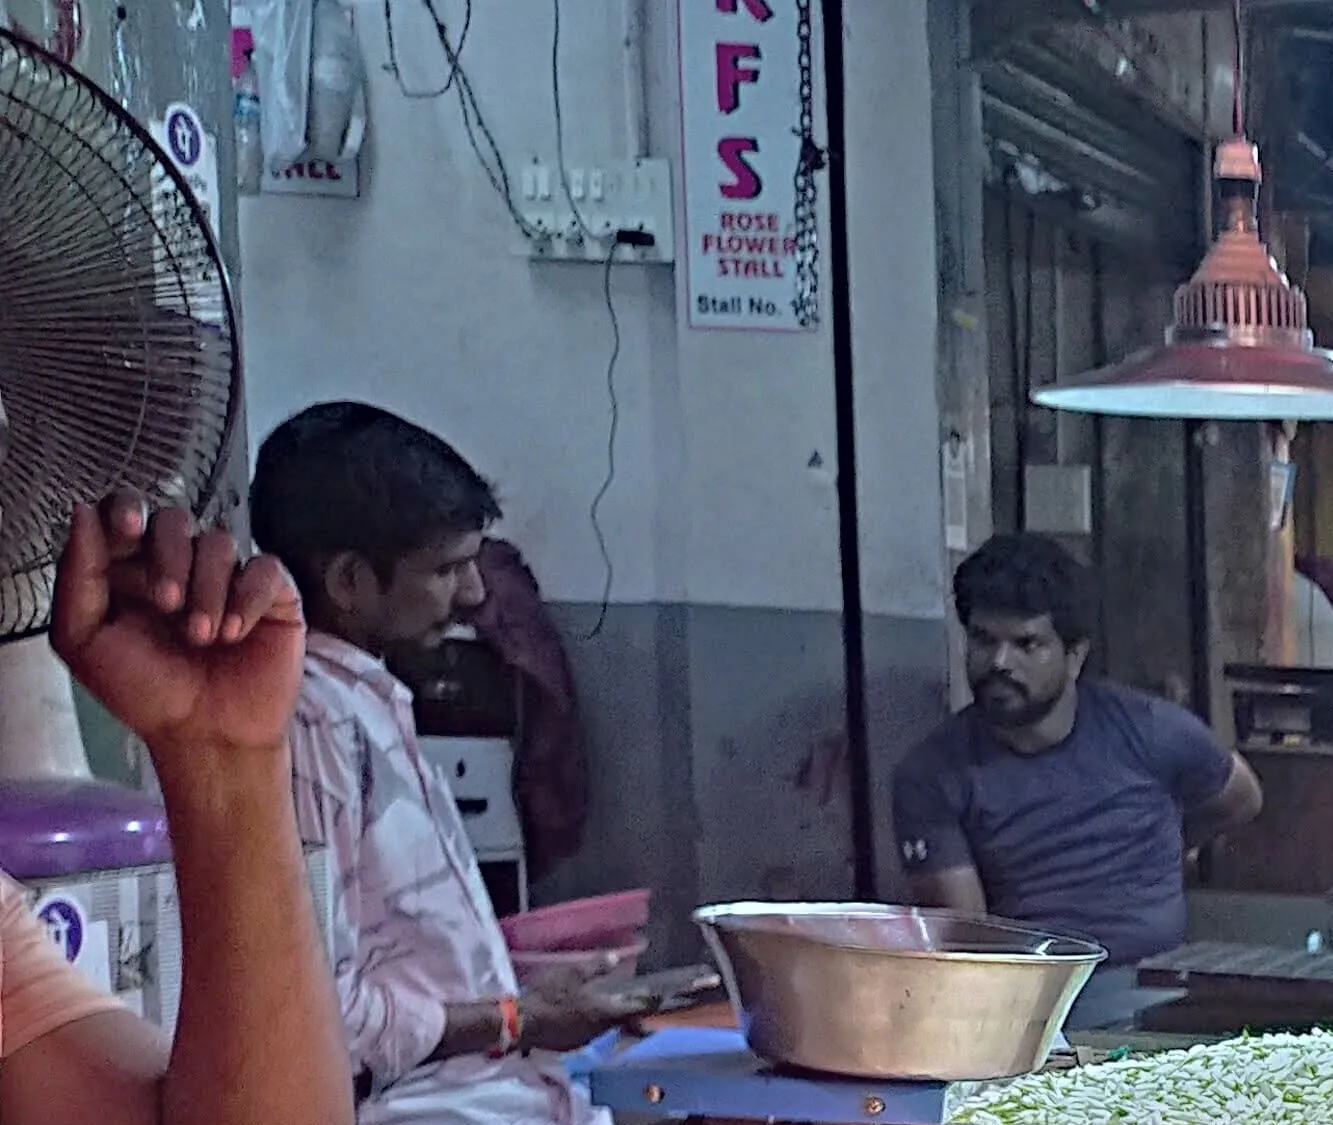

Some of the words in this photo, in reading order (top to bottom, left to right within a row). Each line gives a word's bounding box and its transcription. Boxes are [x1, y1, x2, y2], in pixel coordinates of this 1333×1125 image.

[721, 213, 778, 231] ROSE
[703, 234, 798, 255] FLOWER
[719, 258, 784, 277] STALL
[698, 296, 741, 314] Stall
